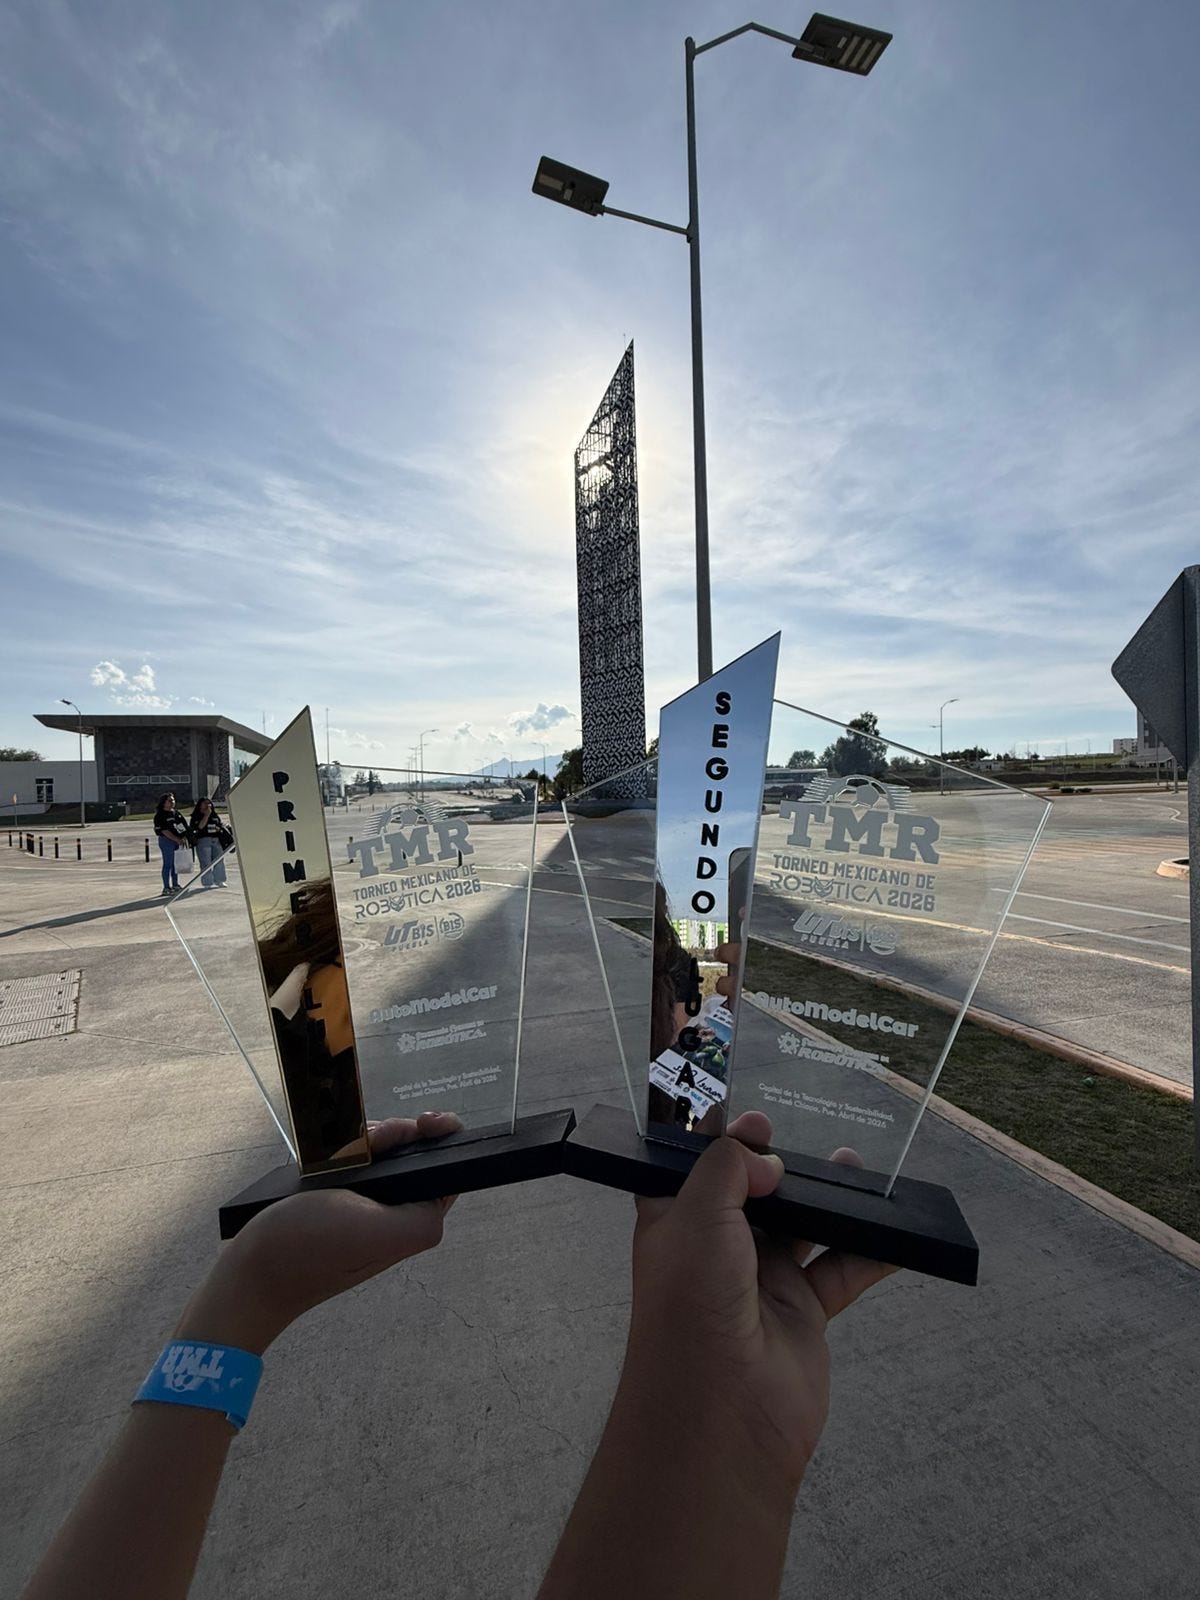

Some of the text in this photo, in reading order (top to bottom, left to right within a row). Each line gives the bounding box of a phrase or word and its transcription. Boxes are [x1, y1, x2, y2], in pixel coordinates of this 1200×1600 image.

[691, 691, 732, 914] SEGUNDO
[347, 818, 475, 878] TMR
[779, 800, 940, 865] TMR
[272, 771, 313, 944] PRIMER
[773, 854, 936, 890] TORNEO MEXICANO DE
[353, 863, 478, 901] TORNEO MEXICANO DE
[446, 879, 481, 899] 2026
[887, 889, 935, 912] 2026
[752, 991, 920, 1038] AutoModelCar
